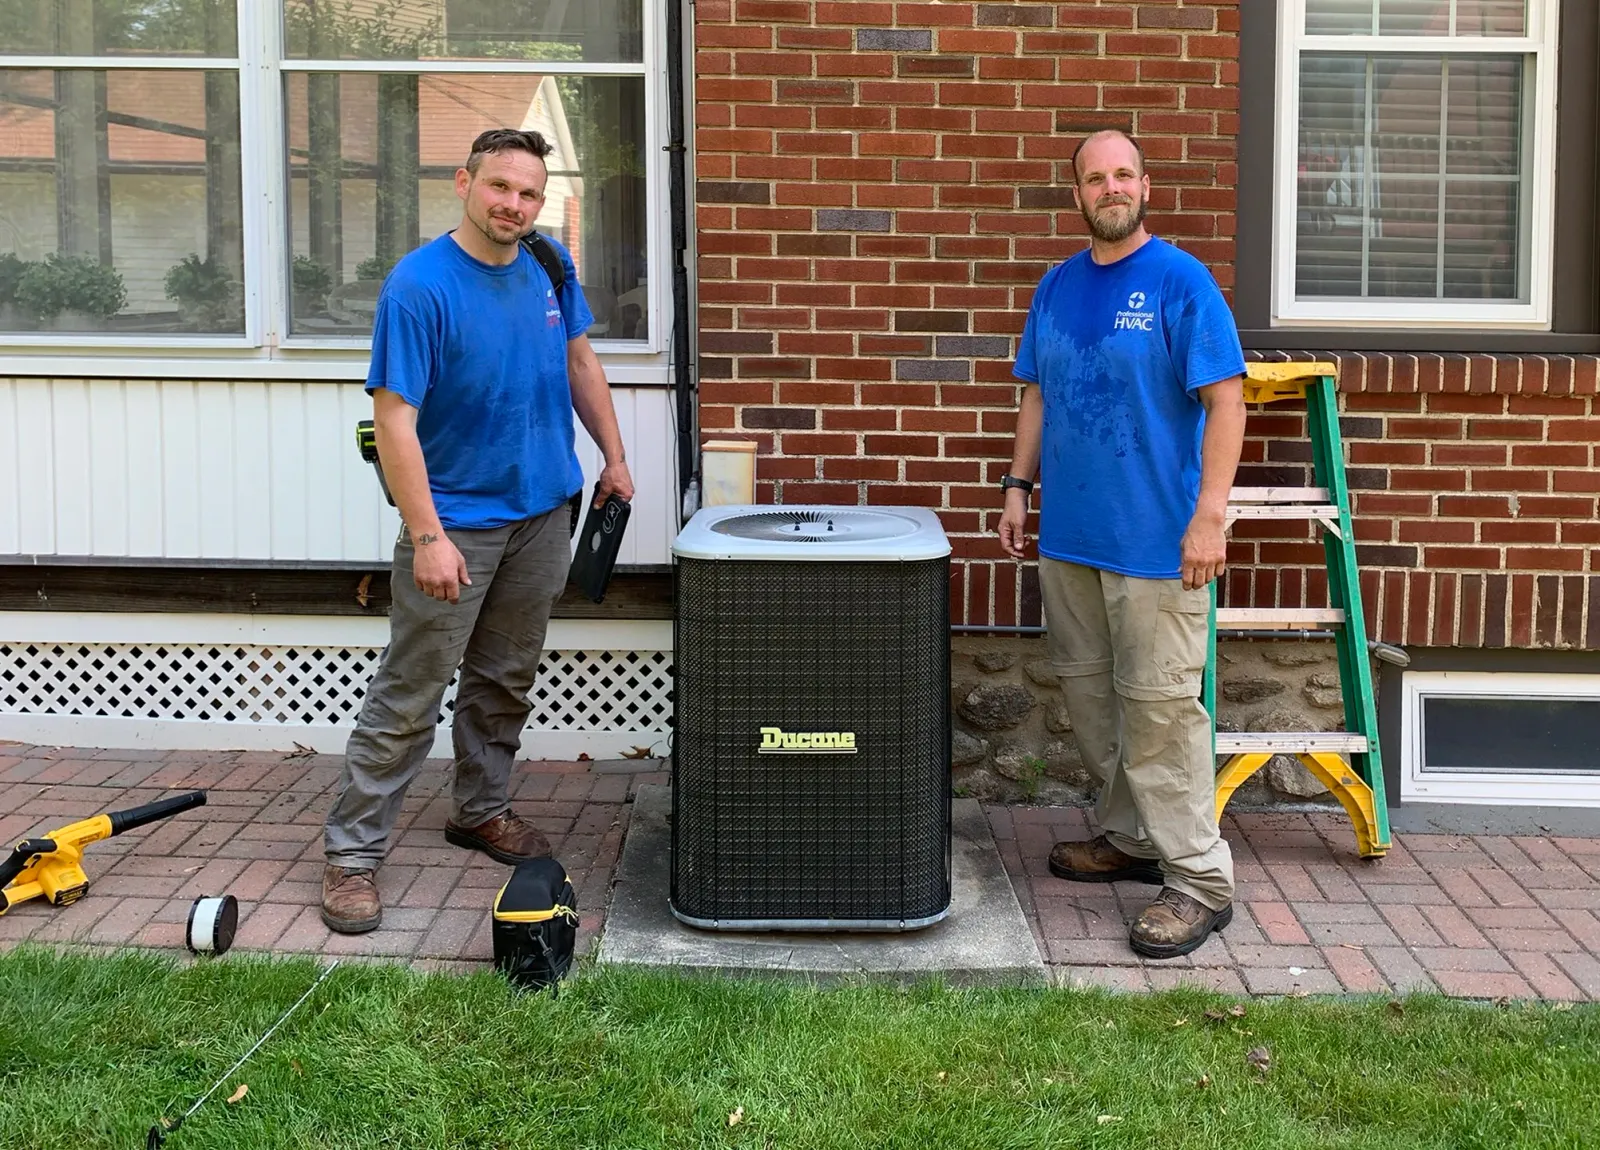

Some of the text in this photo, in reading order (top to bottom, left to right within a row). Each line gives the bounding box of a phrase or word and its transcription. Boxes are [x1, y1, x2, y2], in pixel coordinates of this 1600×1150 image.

[1116, 310, 1155, 318] Professional
[1114, 317, 1153, 331] HVAC
[759, 726, 856, 748] Ducane
